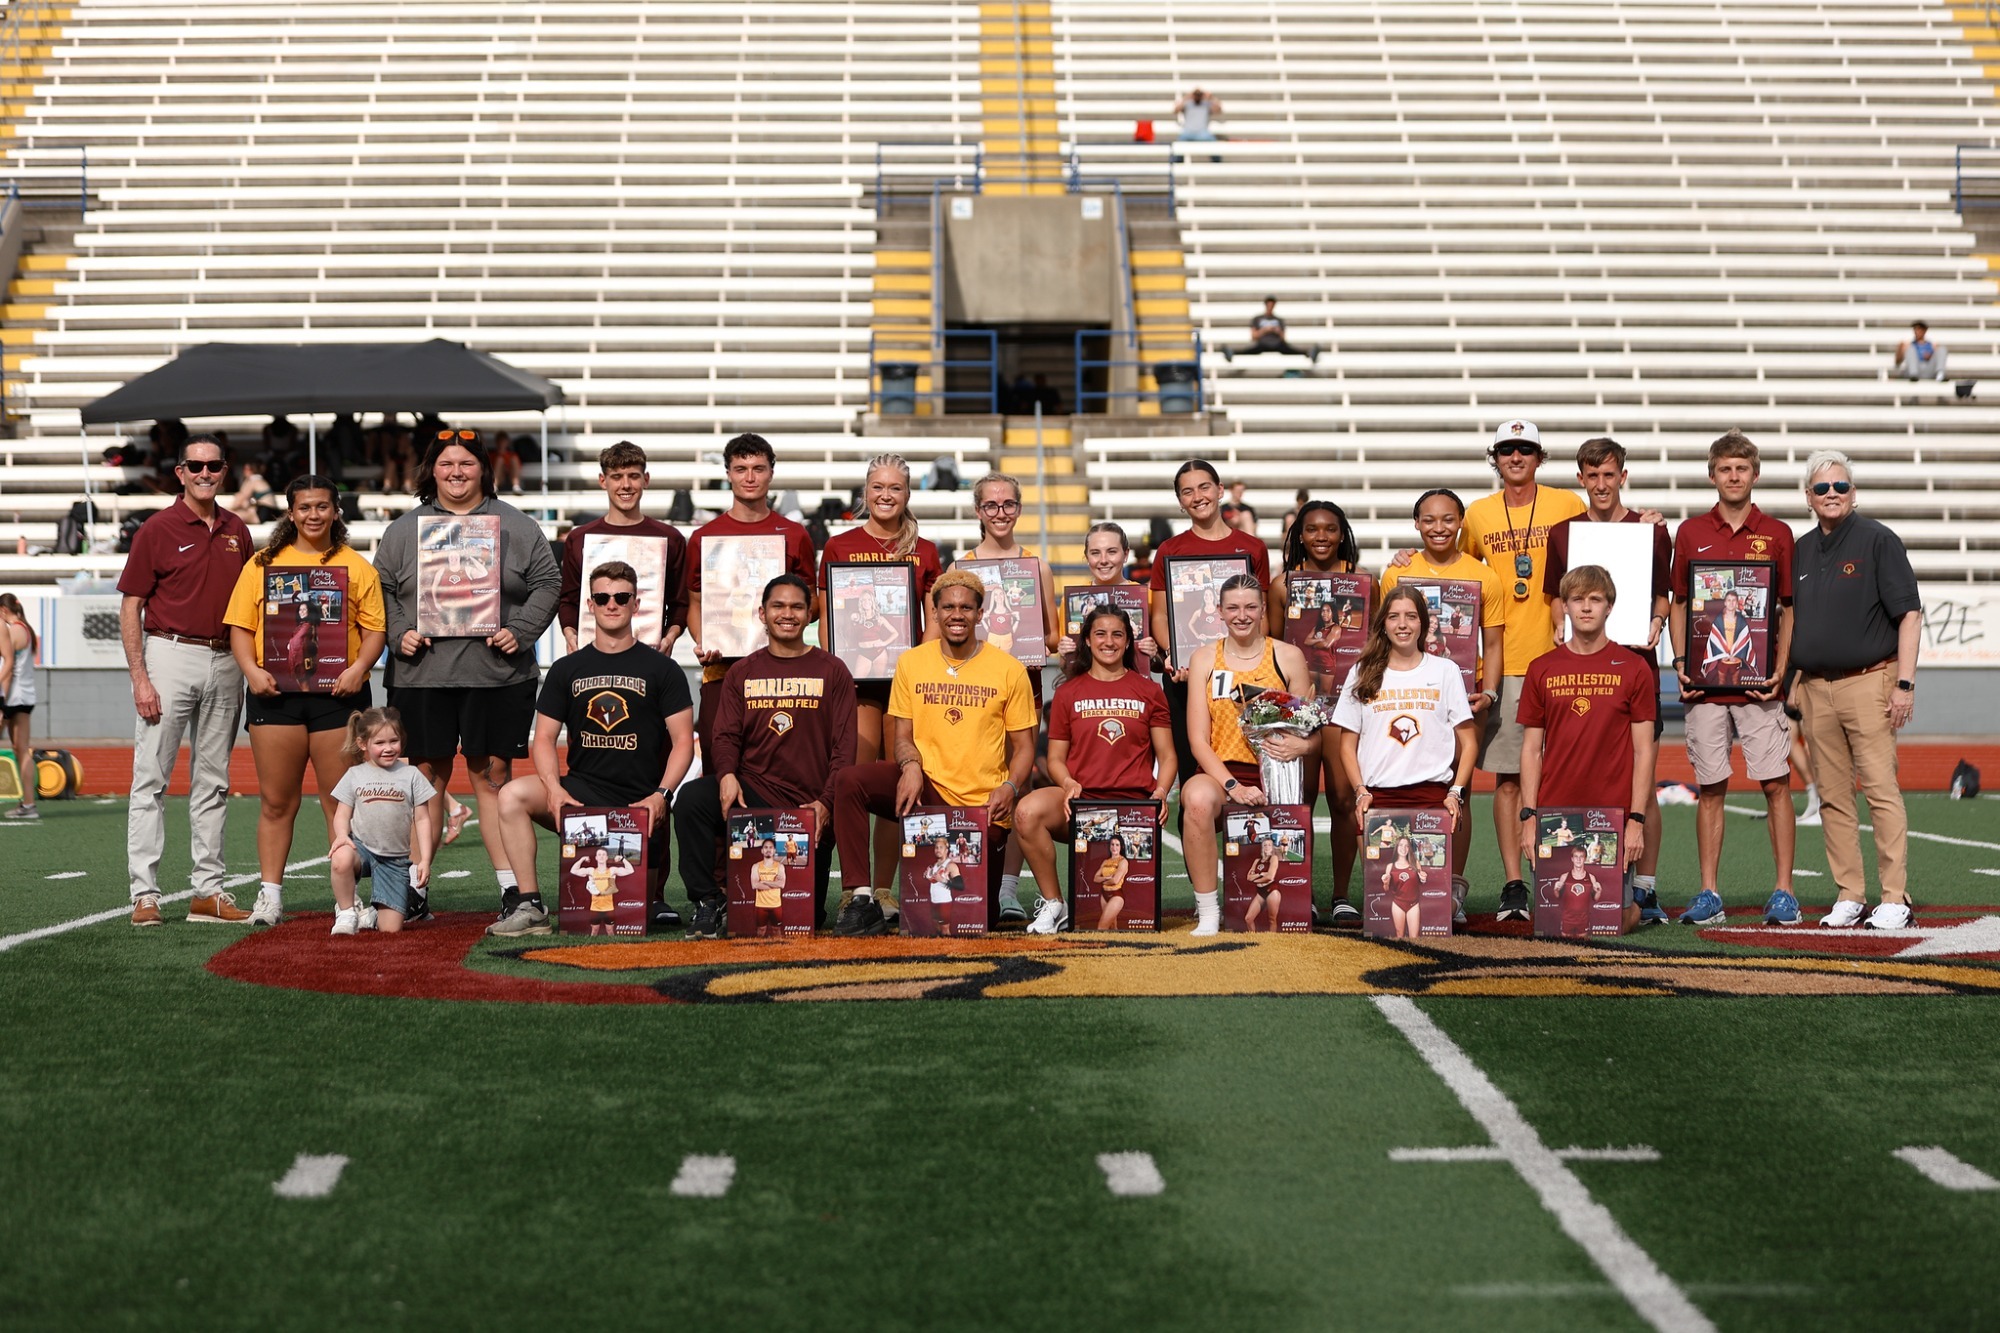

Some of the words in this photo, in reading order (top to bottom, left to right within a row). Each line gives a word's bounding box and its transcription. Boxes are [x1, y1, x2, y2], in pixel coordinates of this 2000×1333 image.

[1483, 524, 1553, 546] CHAMPIONSH
[572, 674, 613, 698] GOLDEN
[612, 674, 647, 698] EAGLE
[744, 678, 824, 698] CHARLESTON
[1215, 672, 1226, 697] 1
[1546, 673, 1621, 689] CHARLESTON
[915, 682, 998, 699] CHAMPIONSHIP
[1551, 688, 1576, 698] TRACK
[1577, 688, 1593, 696] AND
[1593, 687, 1614, 696] FIELD
[747, 700, 775, 710] TRACK
[776, 699, 794, 709] AND
[795, 699, 819, 710] FIELD
[923, 693, 989, 709] MENTALITY
[1074, 698, 1146, 714] CHARLESTON
[1372, 703, 1398, 714] TRACK
[1399, 702, 1414, 711] AND
[1415, 701, 1436, 711] FIELD
[1121, 710, 1139, 718] FIELD
[581, 731, 638, 751] THROWS
[355, 786, 405, 798] Charleston
